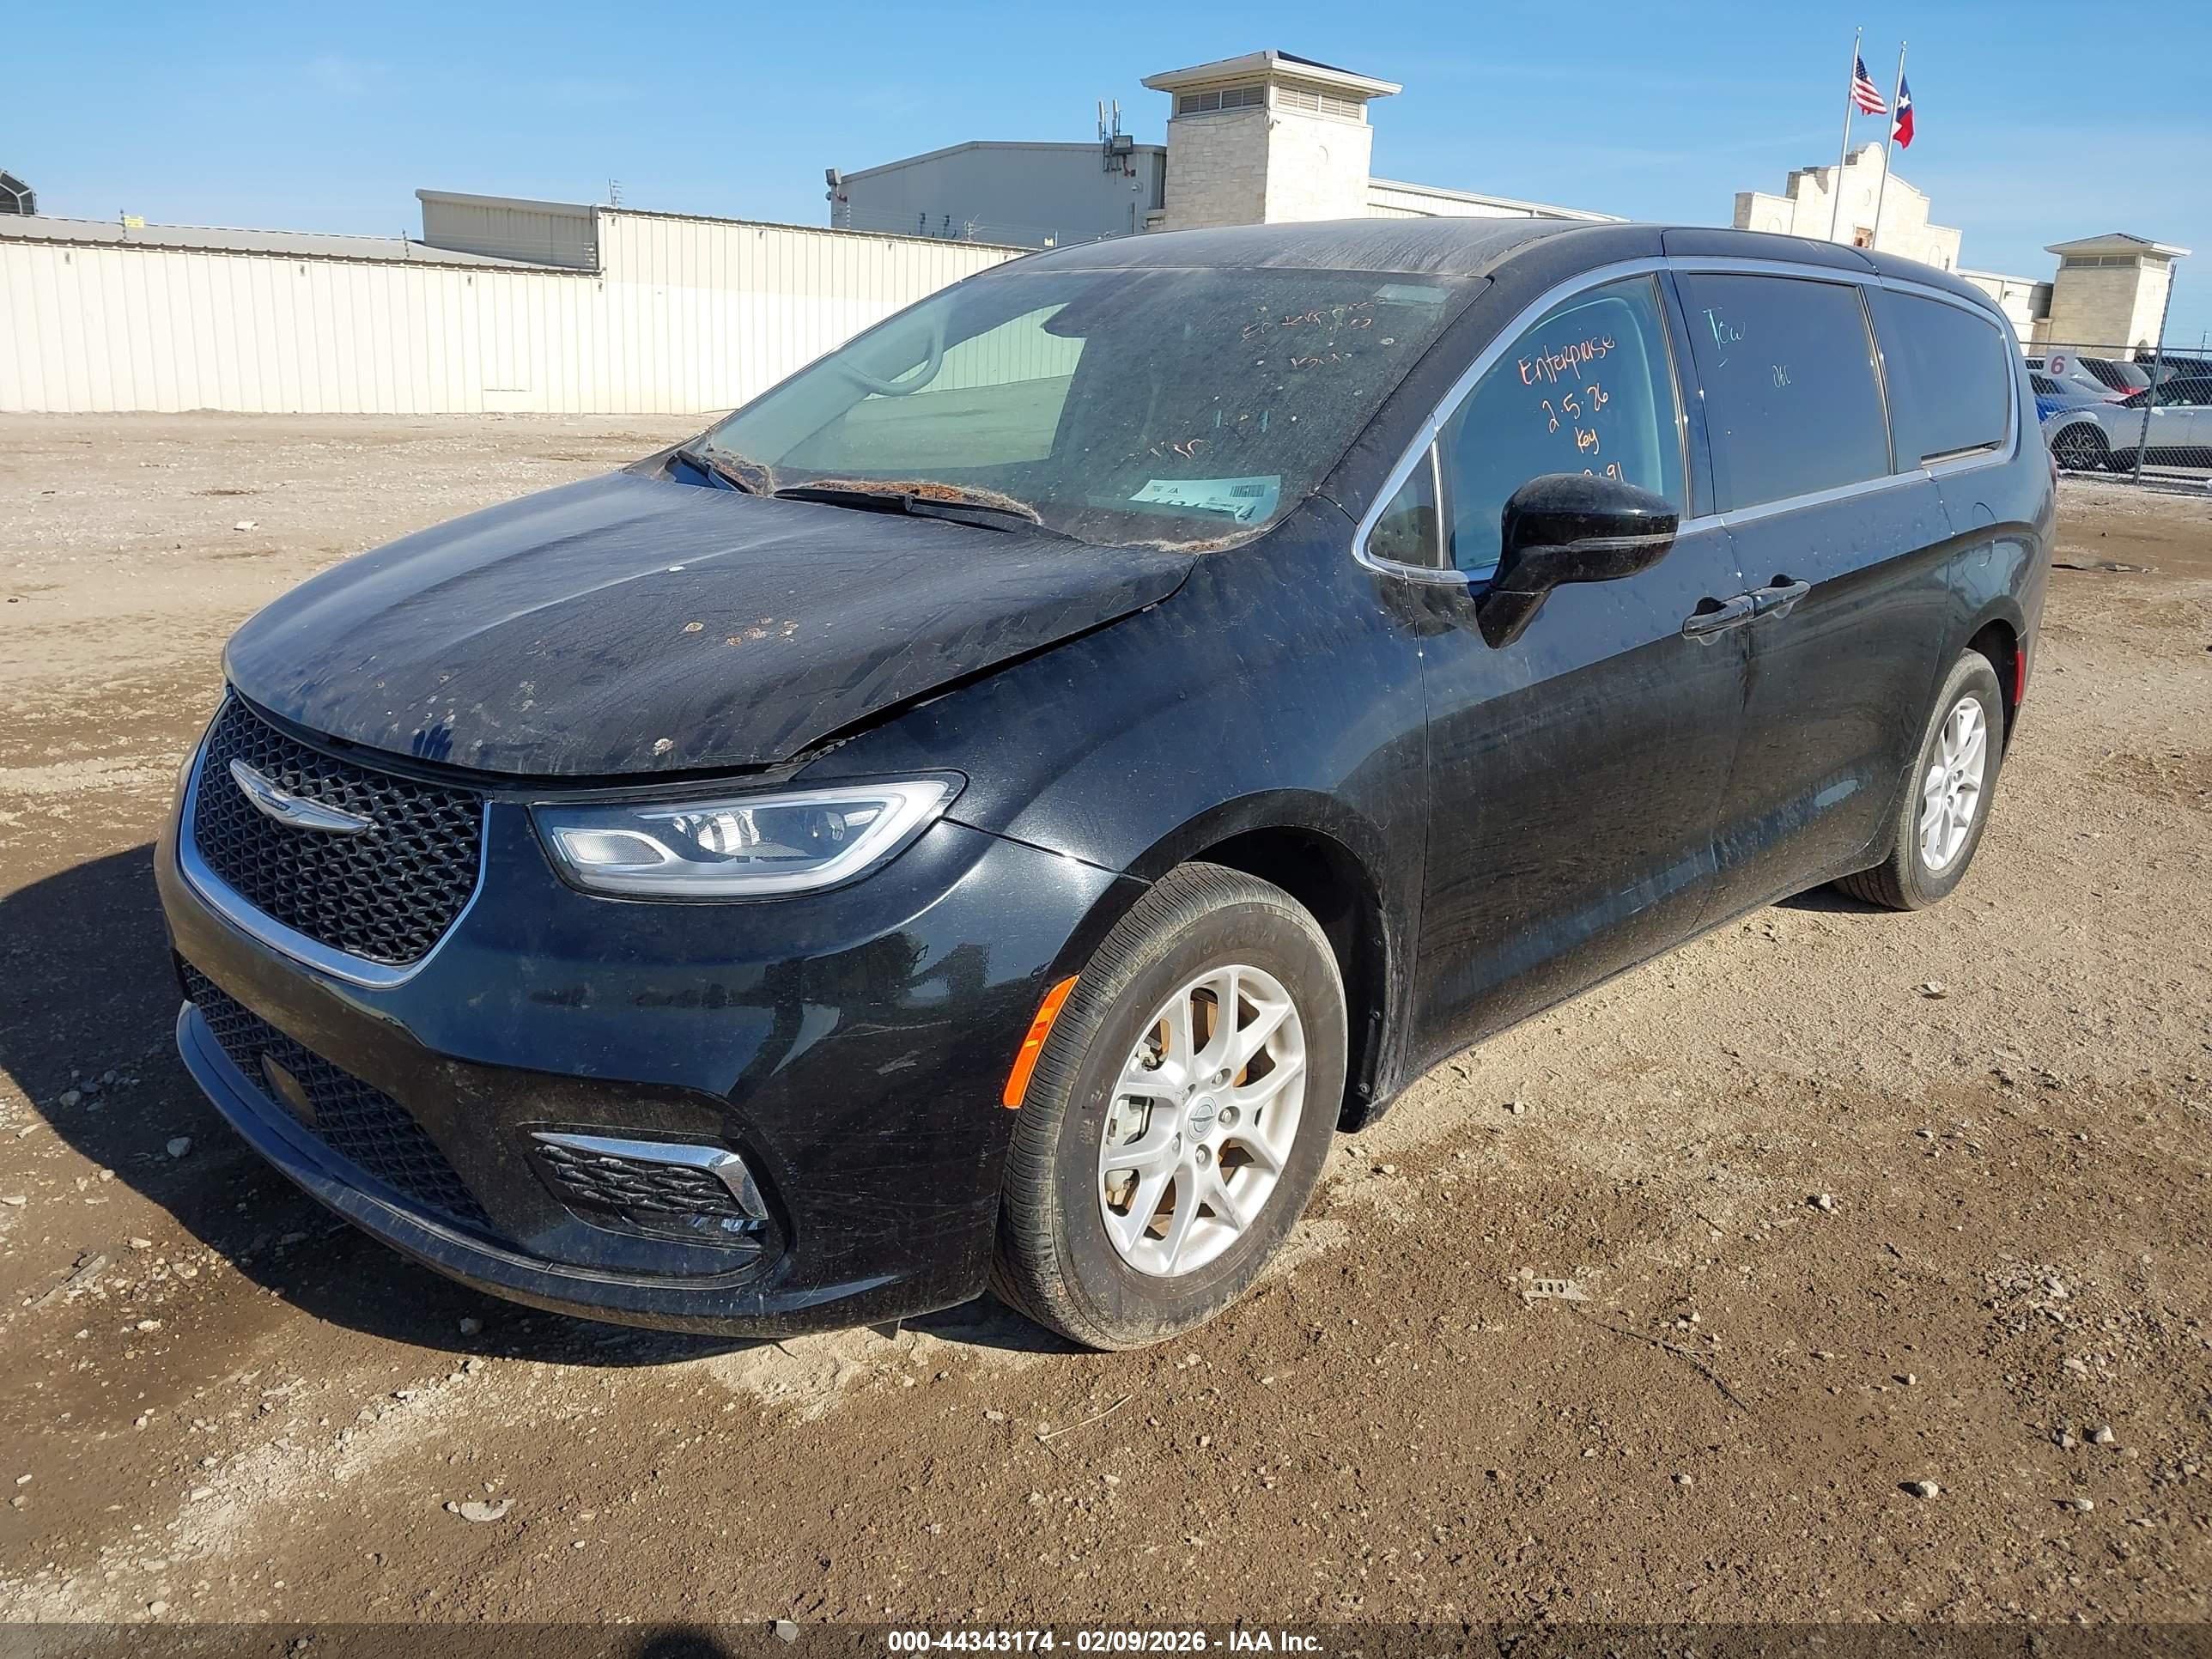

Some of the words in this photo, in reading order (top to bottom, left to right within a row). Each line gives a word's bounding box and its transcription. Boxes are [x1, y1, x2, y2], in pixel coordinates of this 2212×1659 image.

[1517, 332, 1615, 385] Enterprise
[2051, 356, 2066, 375] 6
[1574, 426, 1600, 455] Key
